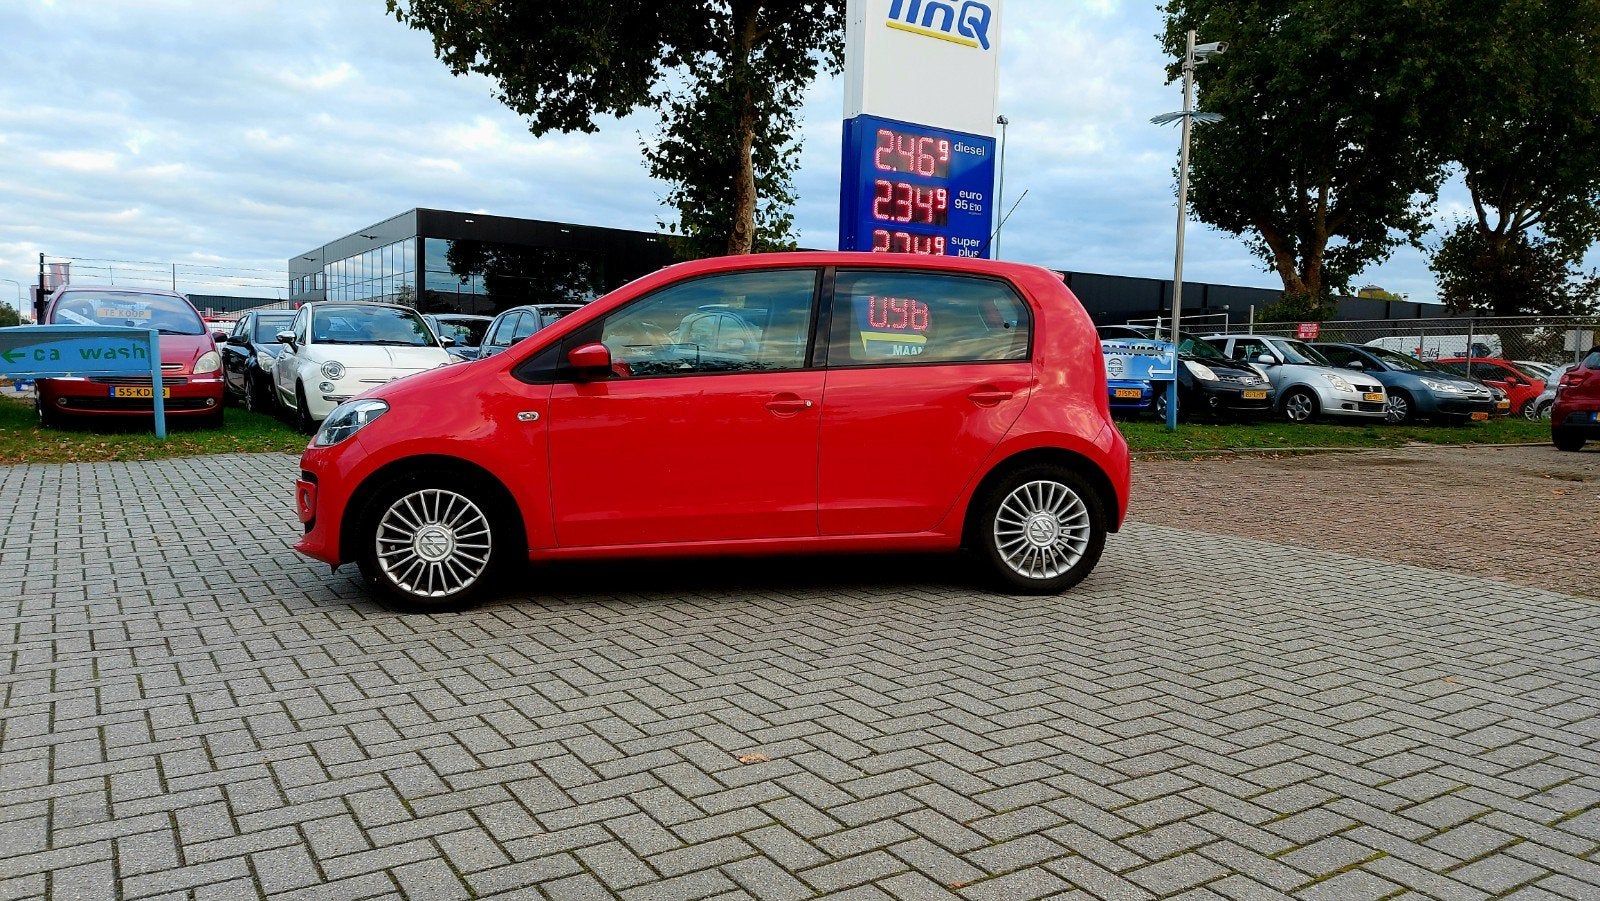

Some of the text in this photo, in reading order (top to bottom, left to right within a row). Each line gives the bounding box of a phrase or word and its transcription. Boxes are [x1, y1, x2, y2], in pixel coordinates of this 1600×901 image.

[954, 141, 985, 156] diesel
[959, 190, 983, 201] euro
[954, 199, 982, 212] 95 E10
[951, 236, 981, 248] super
[958, 247, 979, 258] plus
[104, 309, 145, 318] TE KOOP
[79, 343, 146, 360] wash
